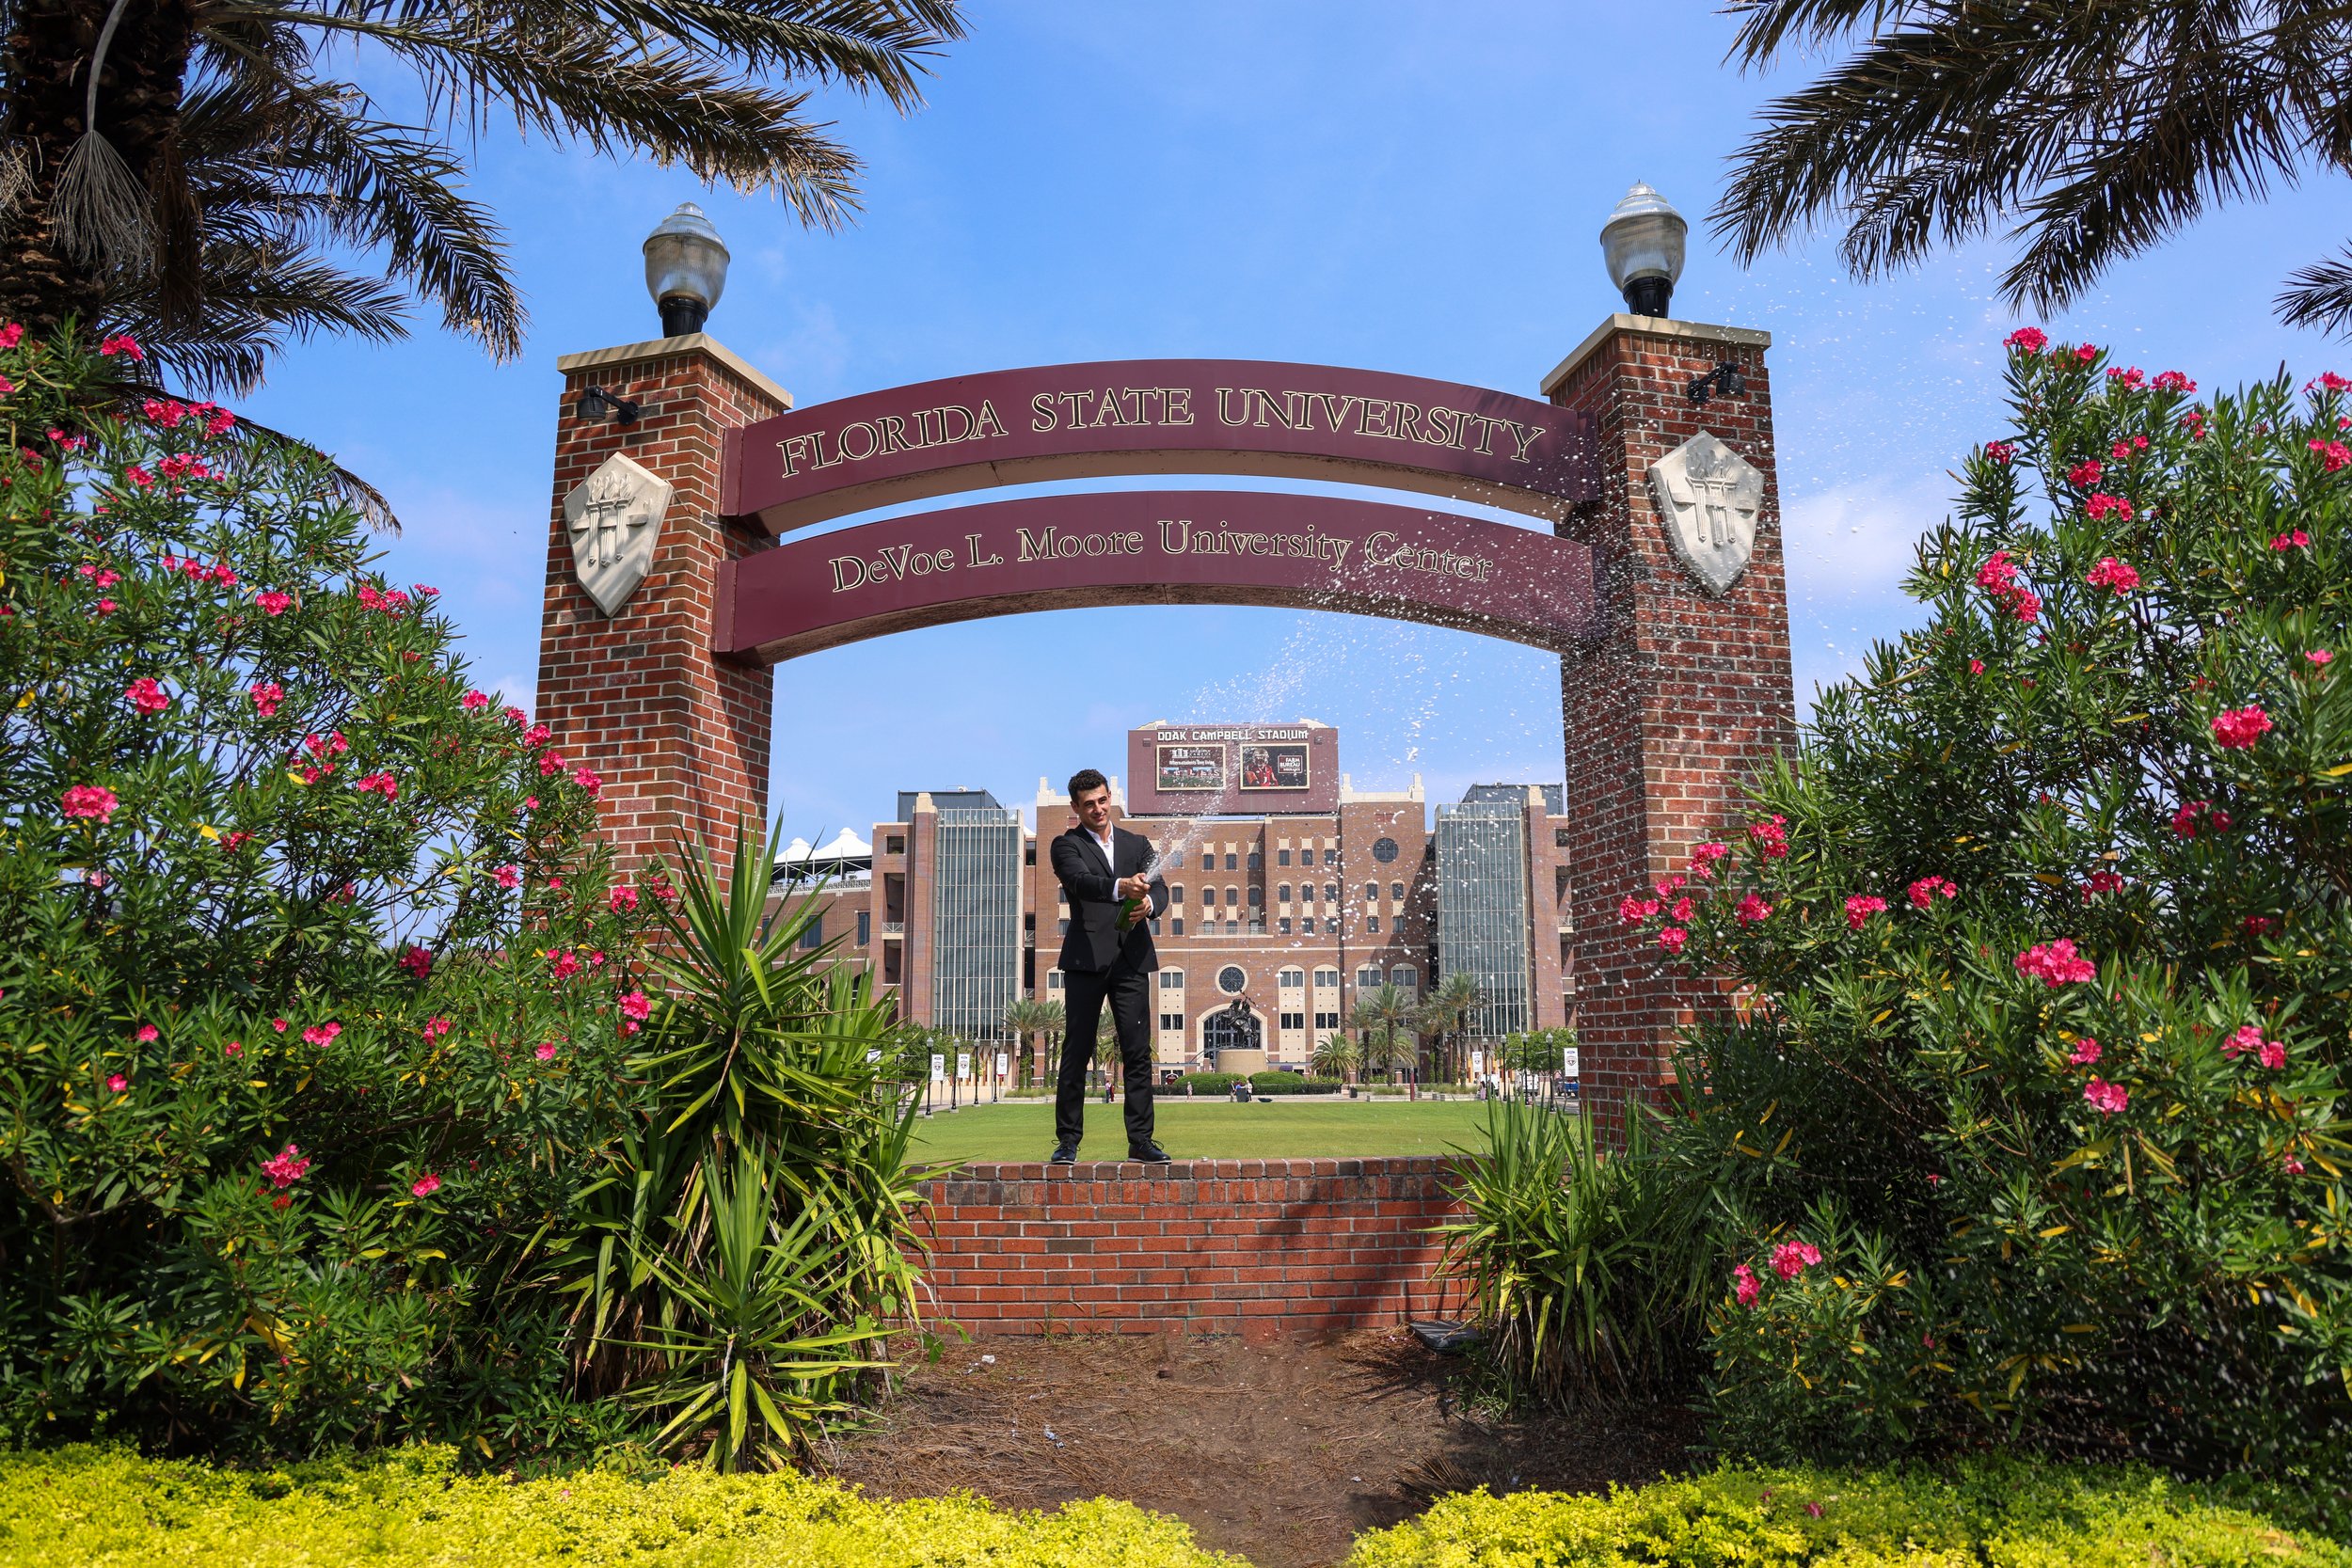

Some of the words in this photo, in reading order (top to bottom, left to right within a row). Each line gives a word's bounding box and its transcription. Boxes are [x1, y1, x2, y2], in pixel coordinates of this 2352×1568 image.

[776, 400, 1008, 478] FLORIDA
[1032, 387, 1195, 433] STATE
[1216, 388, 1546, 464] UNIVERSITY
[829, 544, 955, 593] DeVoe
[965, 534, 1004, 568] L.
[1016, 526, 1144, 562] Moore
[1158, 520, 1353, 571] University
[1364, 531, 1494, 581] Center
[1158, 731, 1186, 741] DOAK
[1192, 730, 1252, 741] CAMPBELL
[1258, 729, 1309, 739] STADIUM
